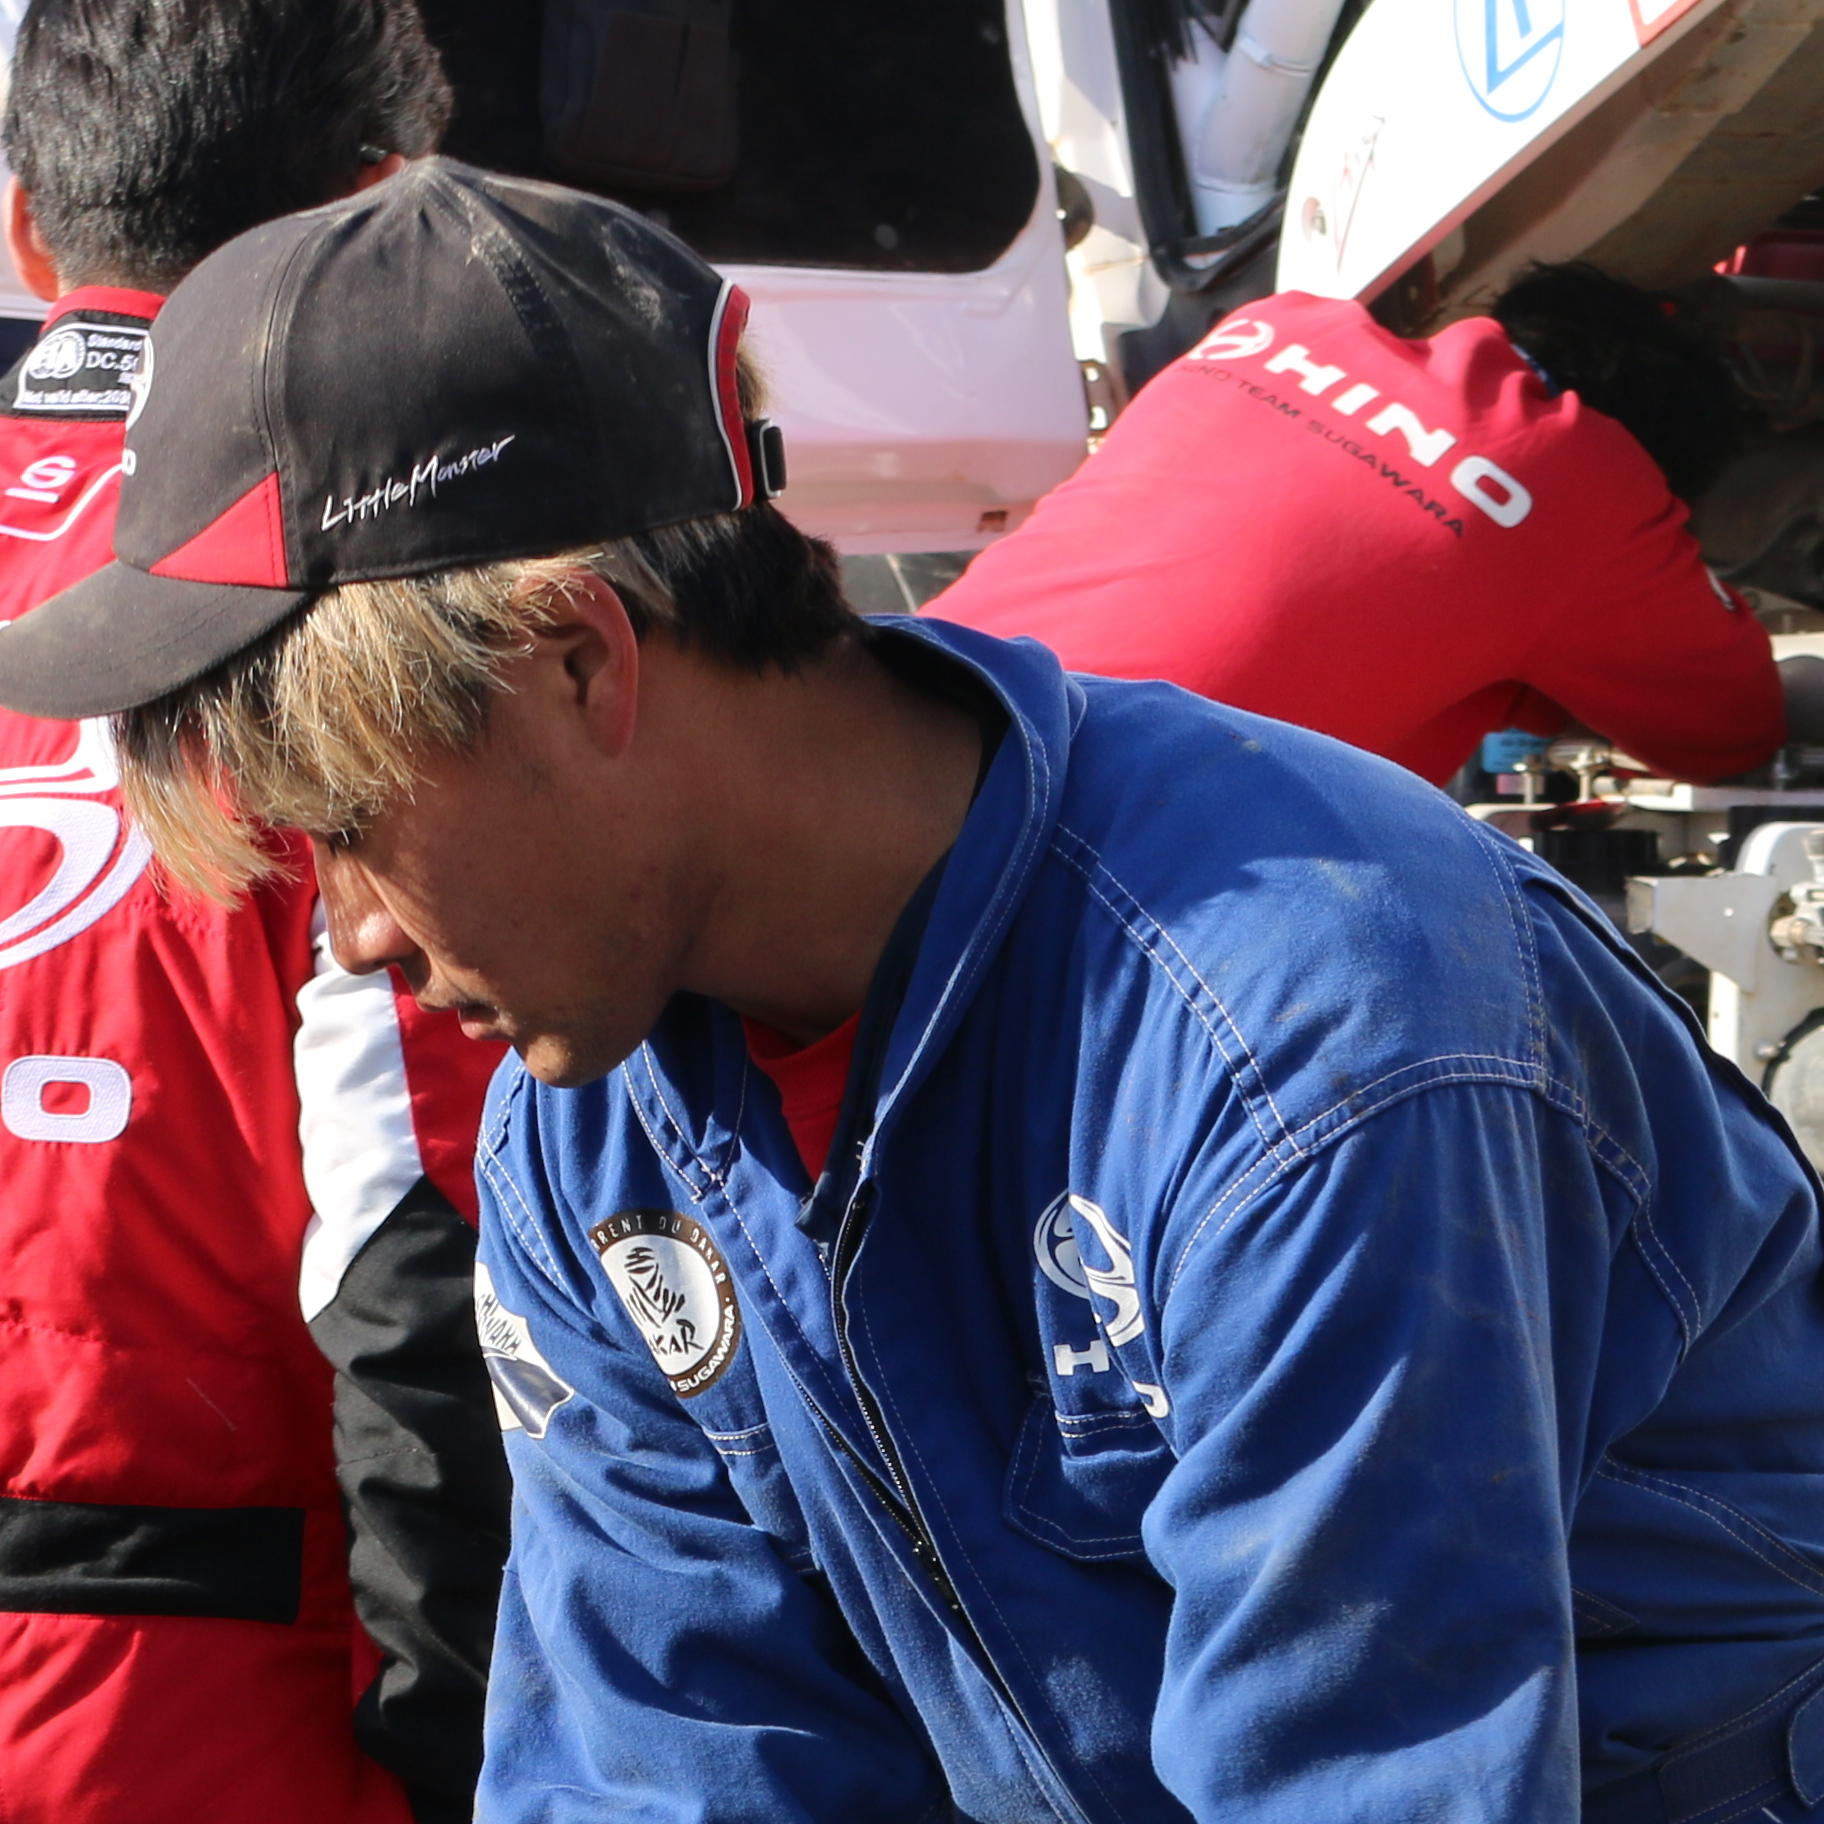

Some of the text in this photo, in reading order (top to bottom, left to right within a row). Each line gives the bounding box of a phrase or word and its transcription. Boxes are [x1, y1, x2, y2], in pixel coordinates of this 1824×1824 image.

[1238, 379, 1302, 419] TEAM
[1304, 419, 1466, 539] SUGAWARA
[1263, 343, 1533, 529] HINO
[690, 1227, 727, 1285] DAKAR
[677, 1304, 737, 1394] SUGAWARA
